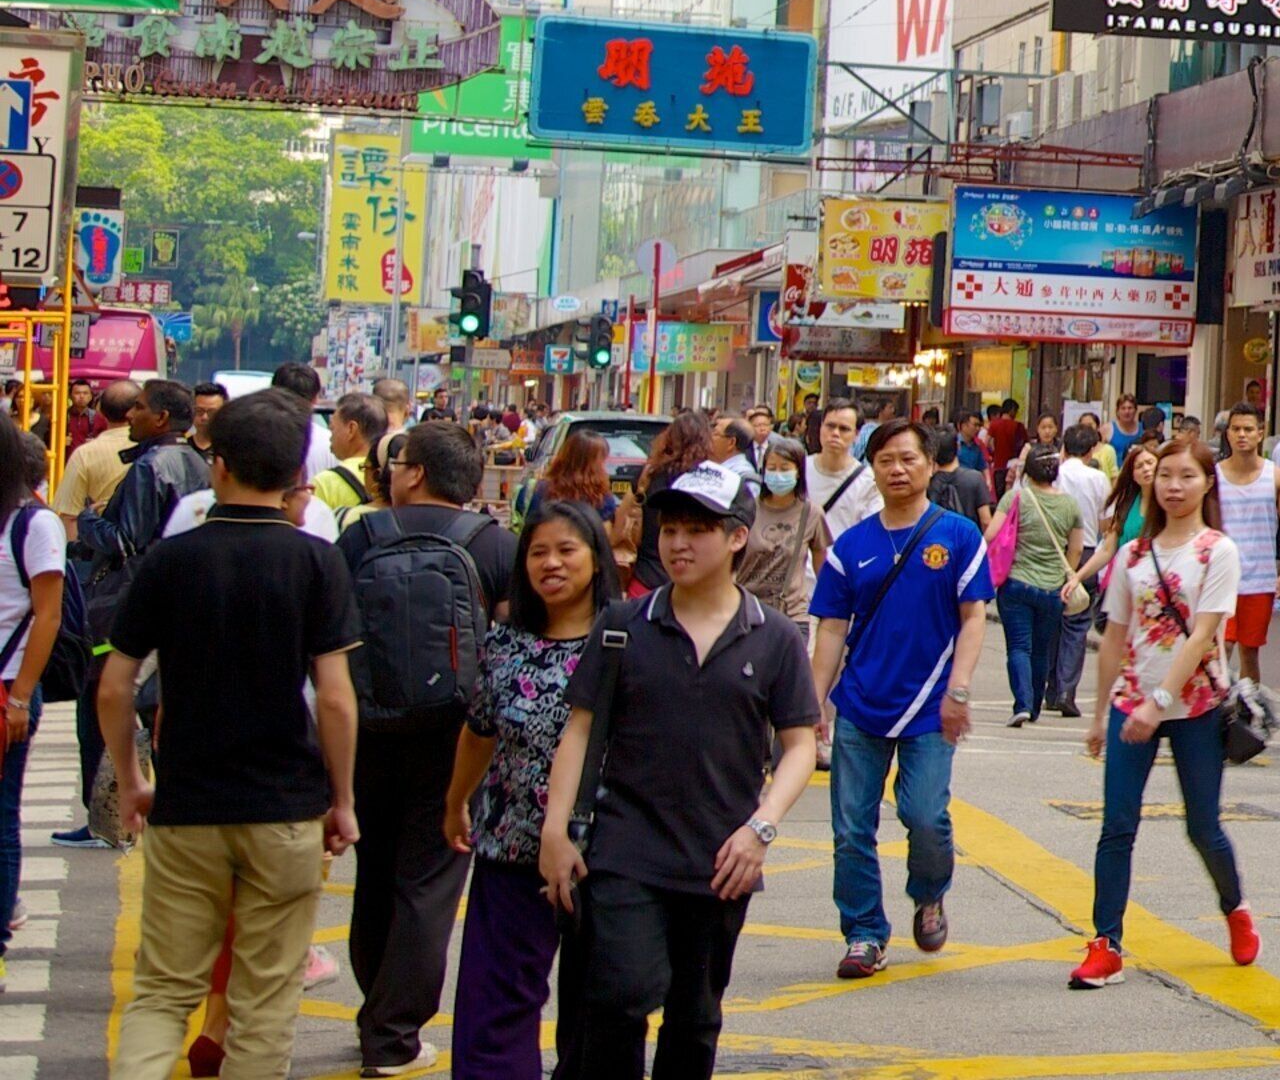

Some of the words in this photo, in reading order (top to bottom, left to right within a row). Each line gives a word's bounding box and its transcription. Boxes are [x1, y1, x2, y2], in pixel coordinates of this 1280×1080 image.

[598, 37, 755, 96] 明苑
[582, 97, 763, 135] 雲吞大王
[338, 146, 416, 236] 譚仔
[13, 211, 28, 232] 7
[12, 248, 40, 268] 12
